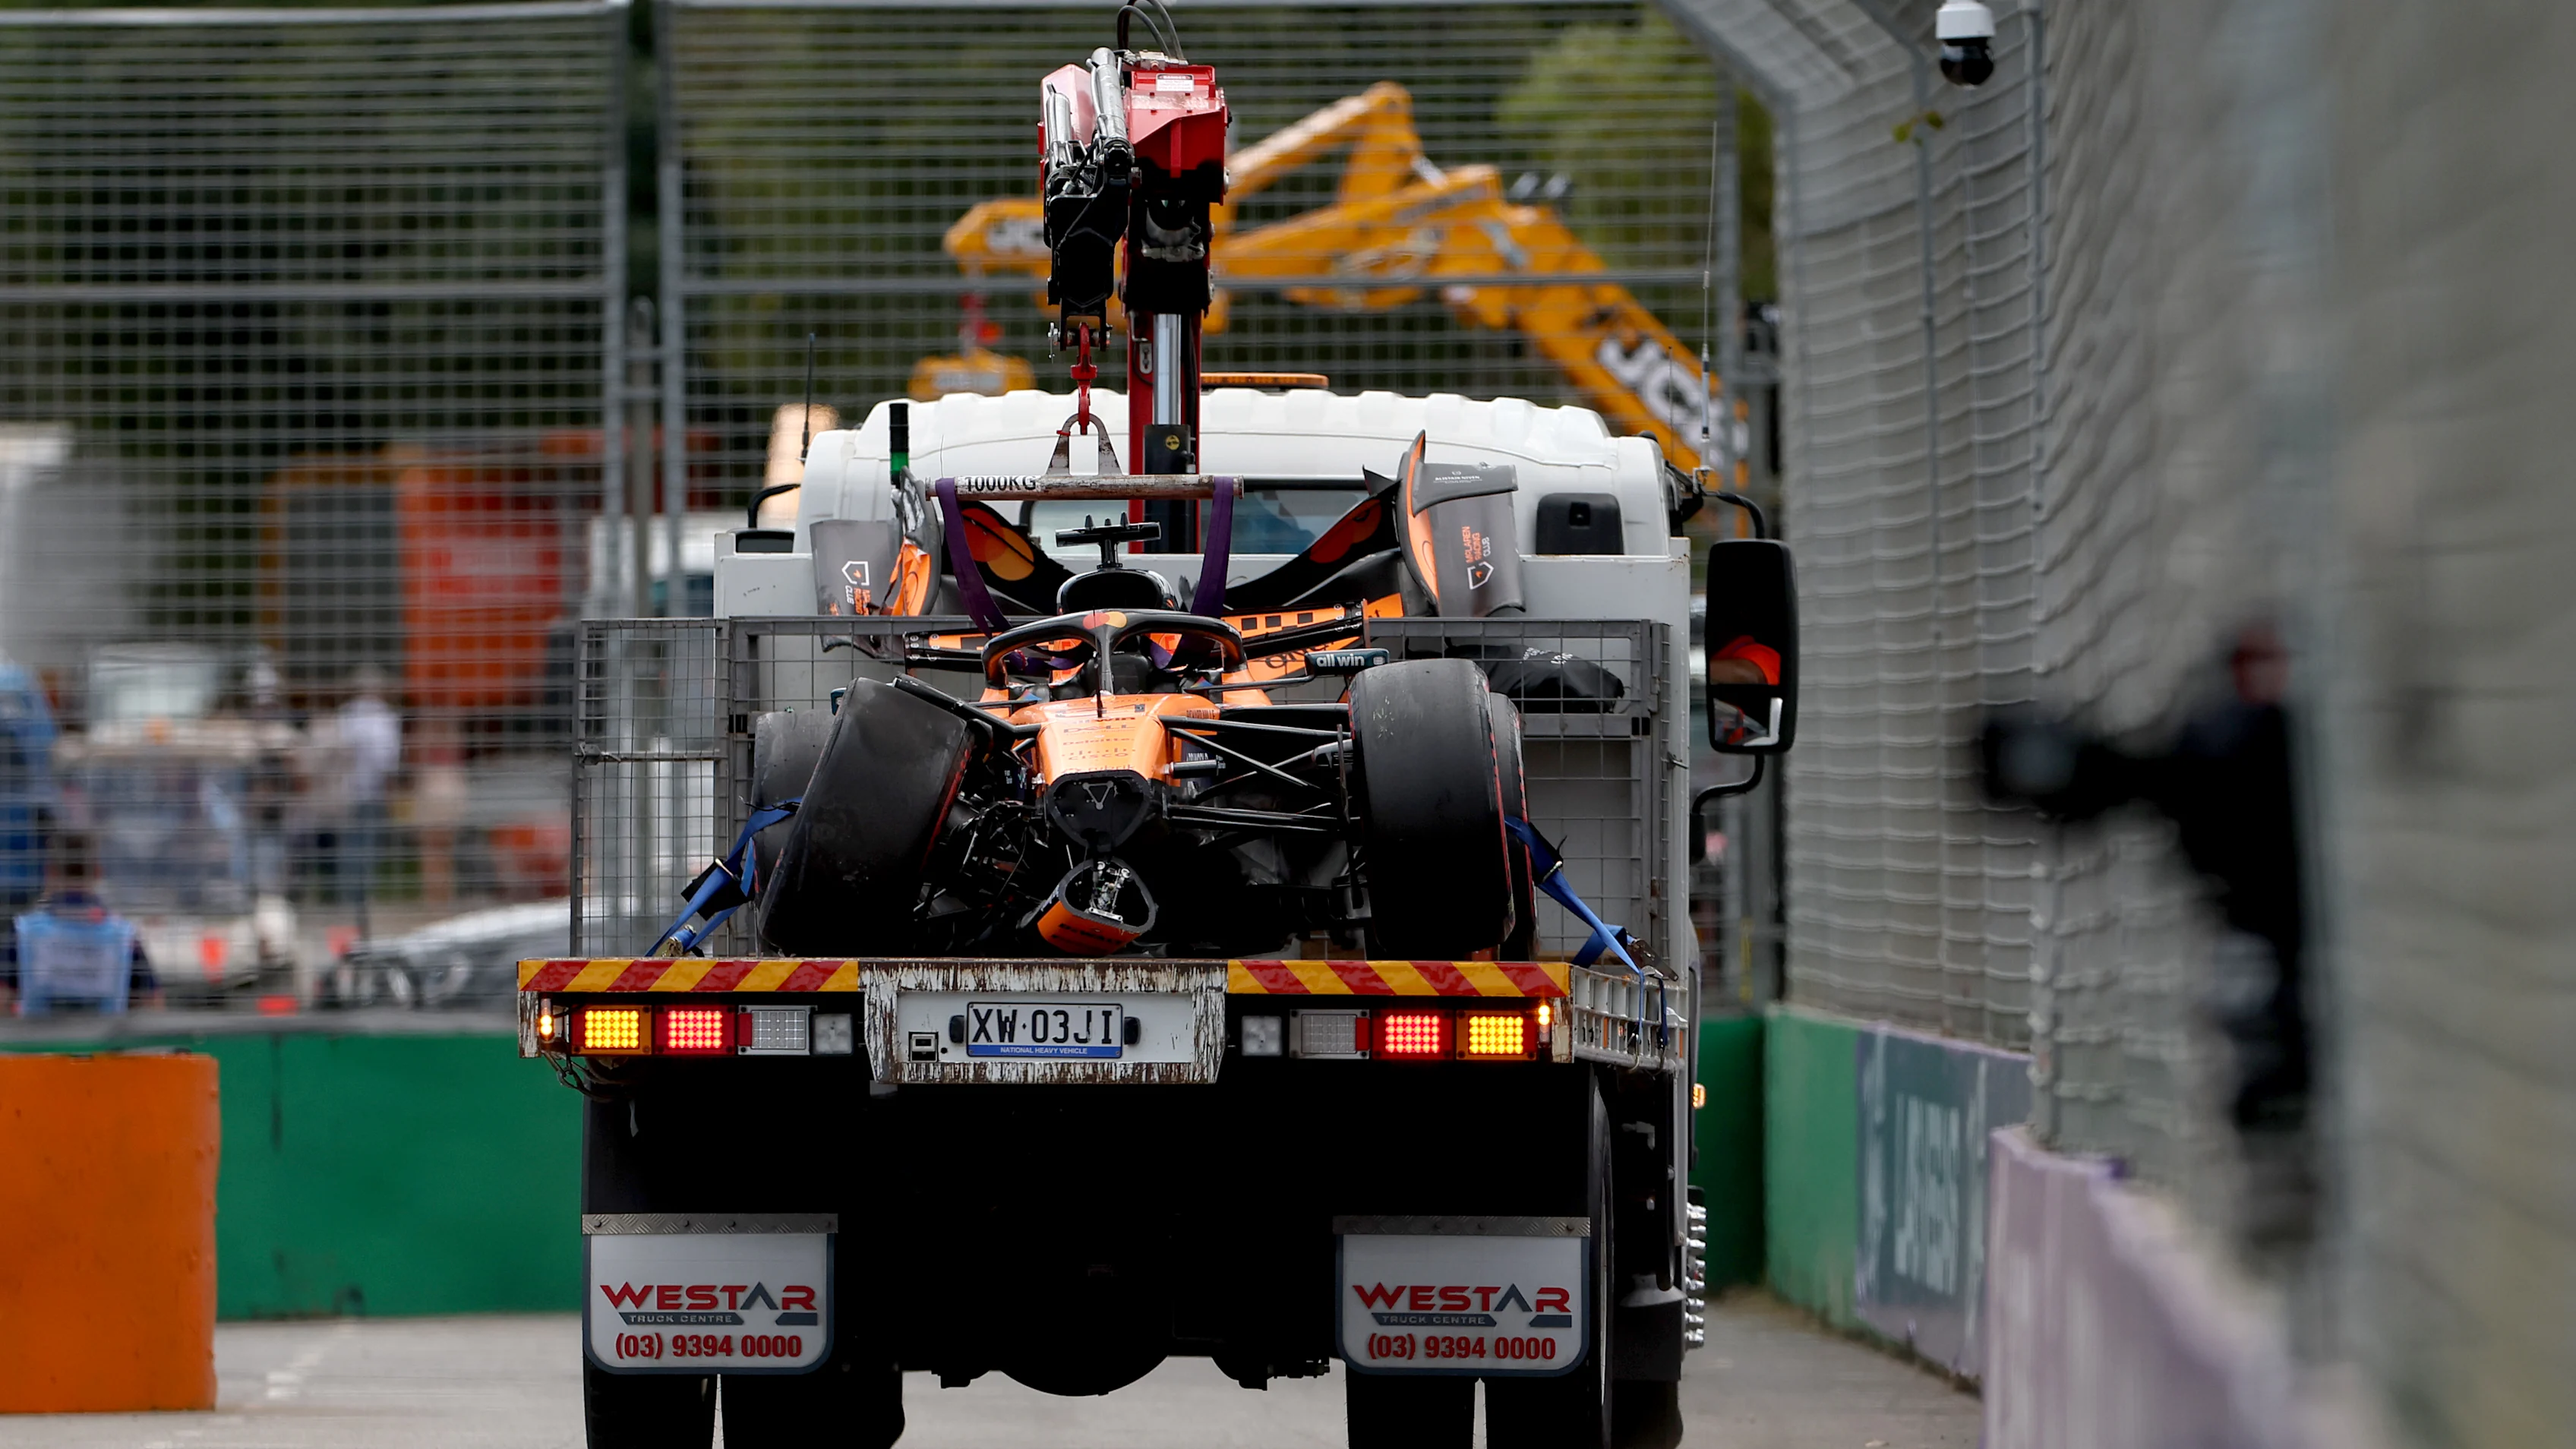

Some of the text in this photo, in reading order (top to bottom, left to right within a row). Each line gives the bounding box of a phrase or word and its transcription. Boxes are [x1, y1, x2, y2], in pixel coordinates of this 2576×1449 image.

[964, 475, 1037, 492] 1000KG
[1482, 536, 1492, 557] CLUB
[1337, 653, 1365, 666] win
[1000, 1046, 1088, 1055] NATIONAL HEAVY VEHICLE
[600, 1281, 818, 1310] WESTAR
[1353, 1282, 1572, 1312] WESTAR
[629, 1315, 733, 1323] TRUCK CENTRE
[1382, 1315, 1486, 1324] TRUCK CENTRE
[615, 1333, 802, 1359] (03) 9394 0000
[1368, 1334, 1556, 1359] (03) 9394 0000
